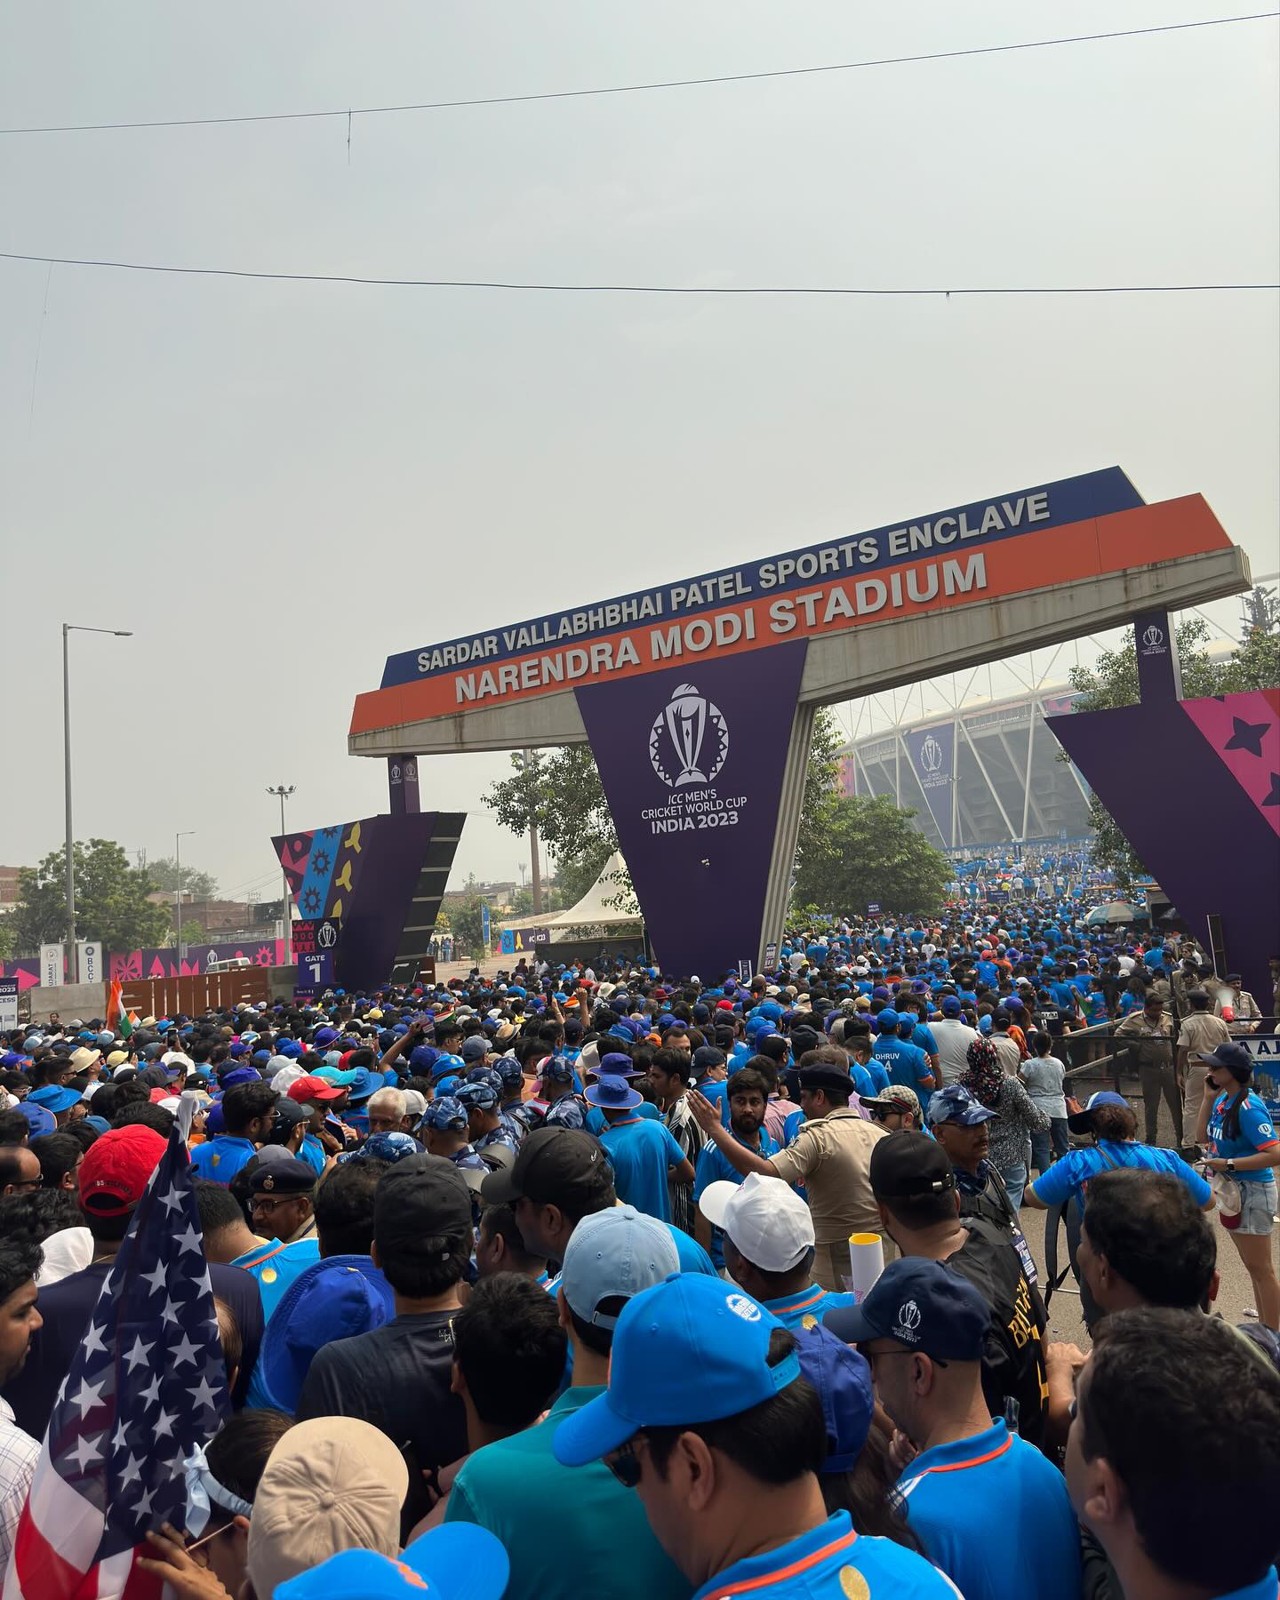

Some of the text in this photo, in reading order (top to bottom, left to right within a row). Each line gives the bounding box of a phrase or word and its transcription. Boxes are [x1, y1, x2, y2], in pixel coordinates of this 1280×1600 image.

[417, 491, 1050, 672] SARDAR VALLABHBHAI PATEL SPORTS ENCLAVE
[455, 552, 987, 704] NARENDRA MODI STADIUM
[641, 796, 748, 819] CRICKET WORLD CUP
[668, 788, 717, 805] ICC MEN'S
[651, 811, 739, 834] INDIA 2023
[304, 954, 326, 962] GATE
[308, 963, 321, 983] 1
